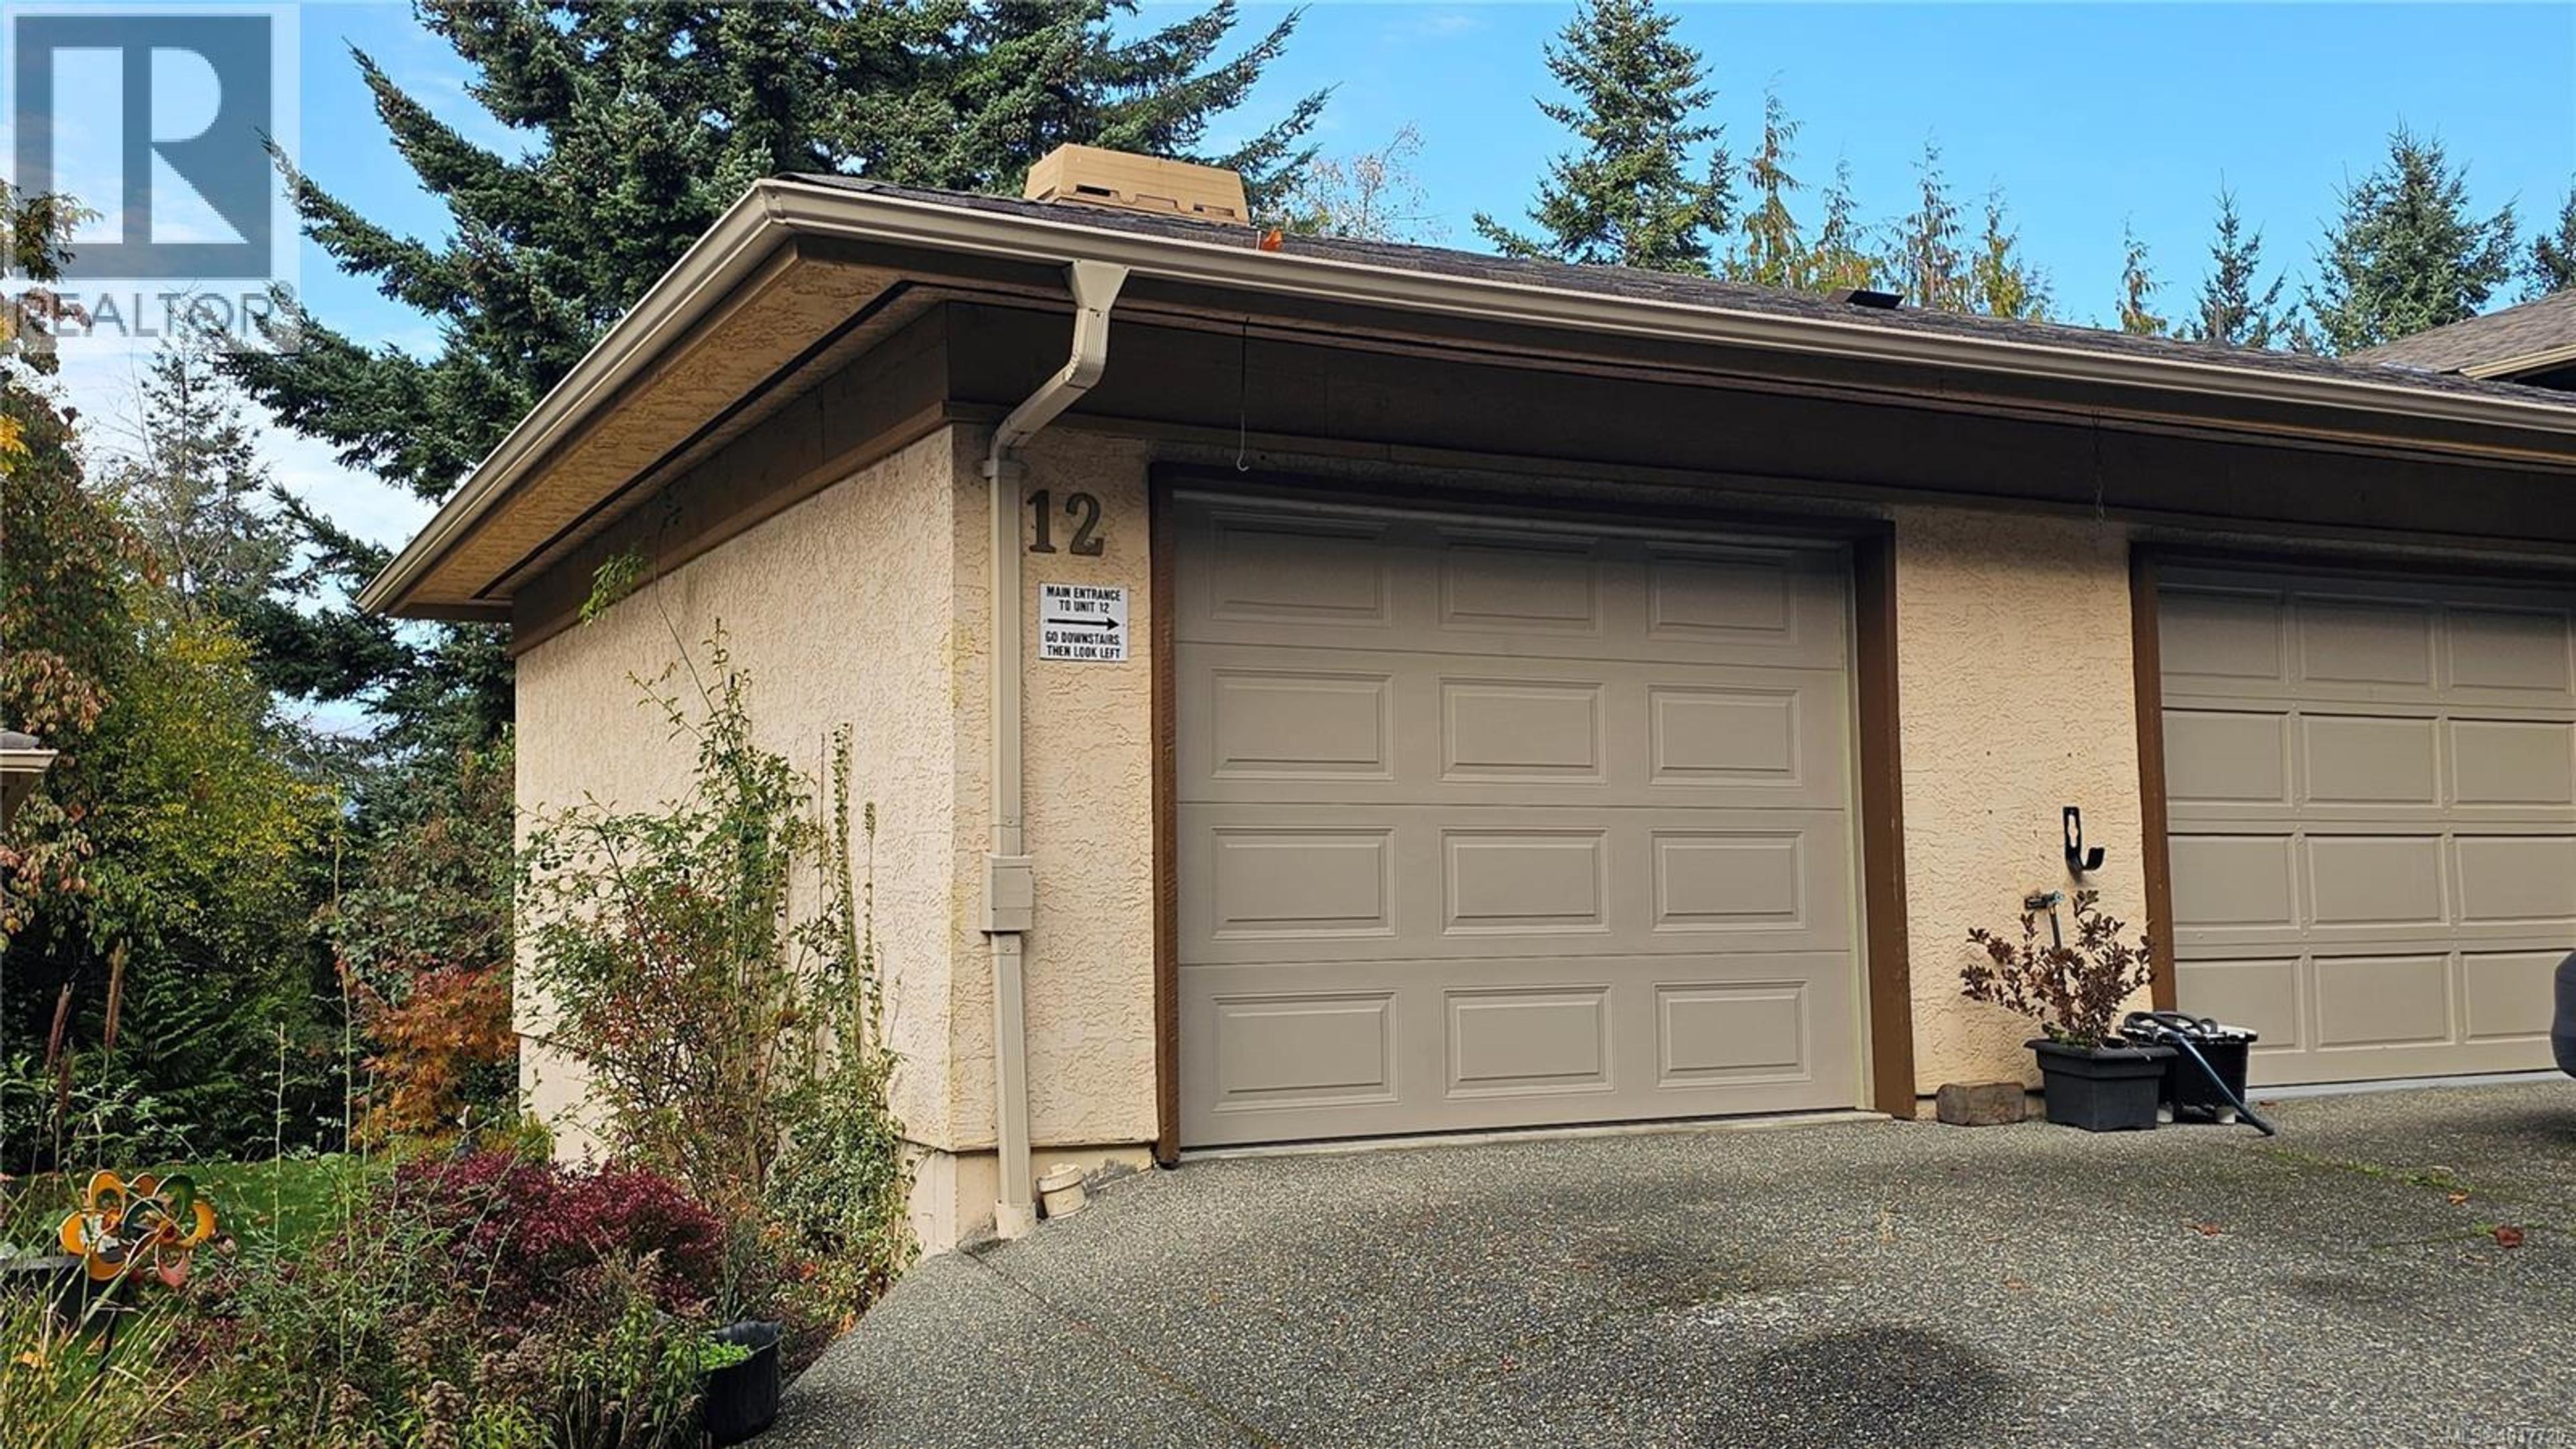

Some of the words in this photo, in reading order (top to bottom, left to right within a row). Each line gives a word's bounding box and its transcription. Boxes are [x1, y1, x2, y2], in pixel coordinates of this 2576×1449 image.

[1026, 489, 1104, 556] 12
[1046, 586, 1071, 598] MAIN
[1074, 588, 1121, 602] ENTRANCE
[1059, 600, 1071, 611] TO
[1074, 601, 1095, 612] UNIT
[1099, 602, 1110, 614] 12
[1045, 631, 1059, 643] GO
[1047, 645, 1071, 657] THEN
[1074, 646, 1097, 658] LOOK
[1100, 647, 1121, 659] LEFT
